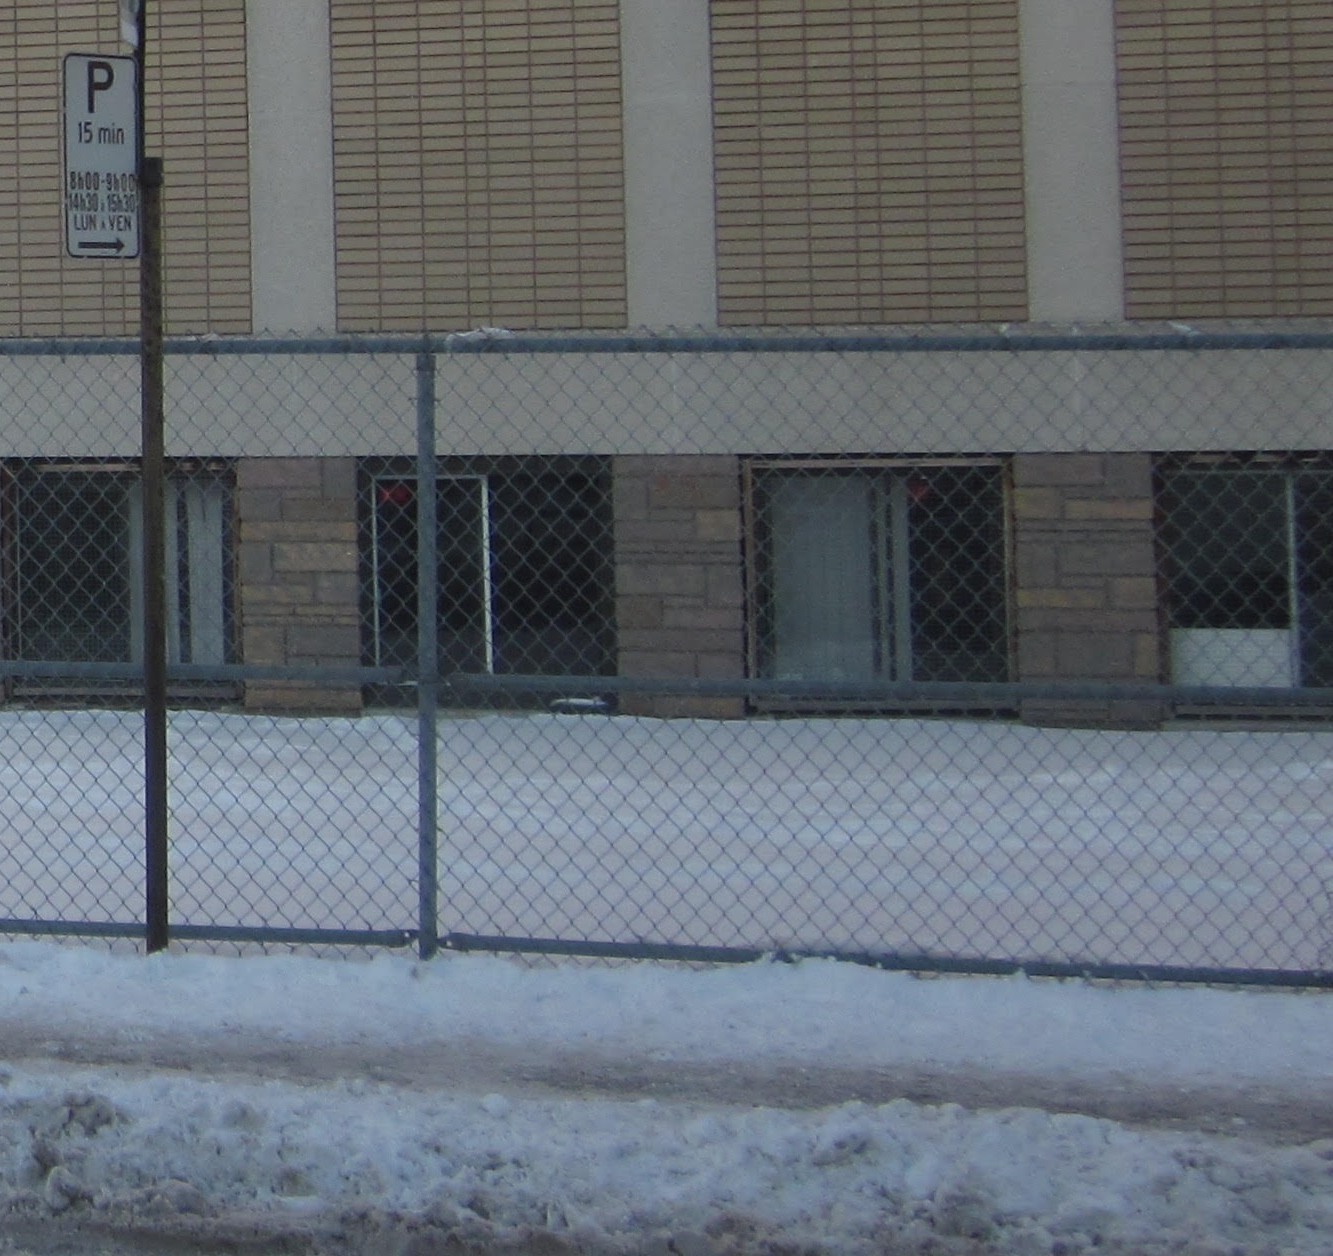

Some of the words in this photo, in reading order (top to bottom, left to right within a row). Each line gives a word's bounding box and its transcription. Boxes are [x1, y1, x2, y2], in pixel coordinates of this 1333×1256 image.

[88, 61, 114, 114] P
[78, 121, 93, 144] 15
[98, 122, 124, 145] min
[74, 214, 97, 231] LUN
[108, 215, 132, 232] VEN
